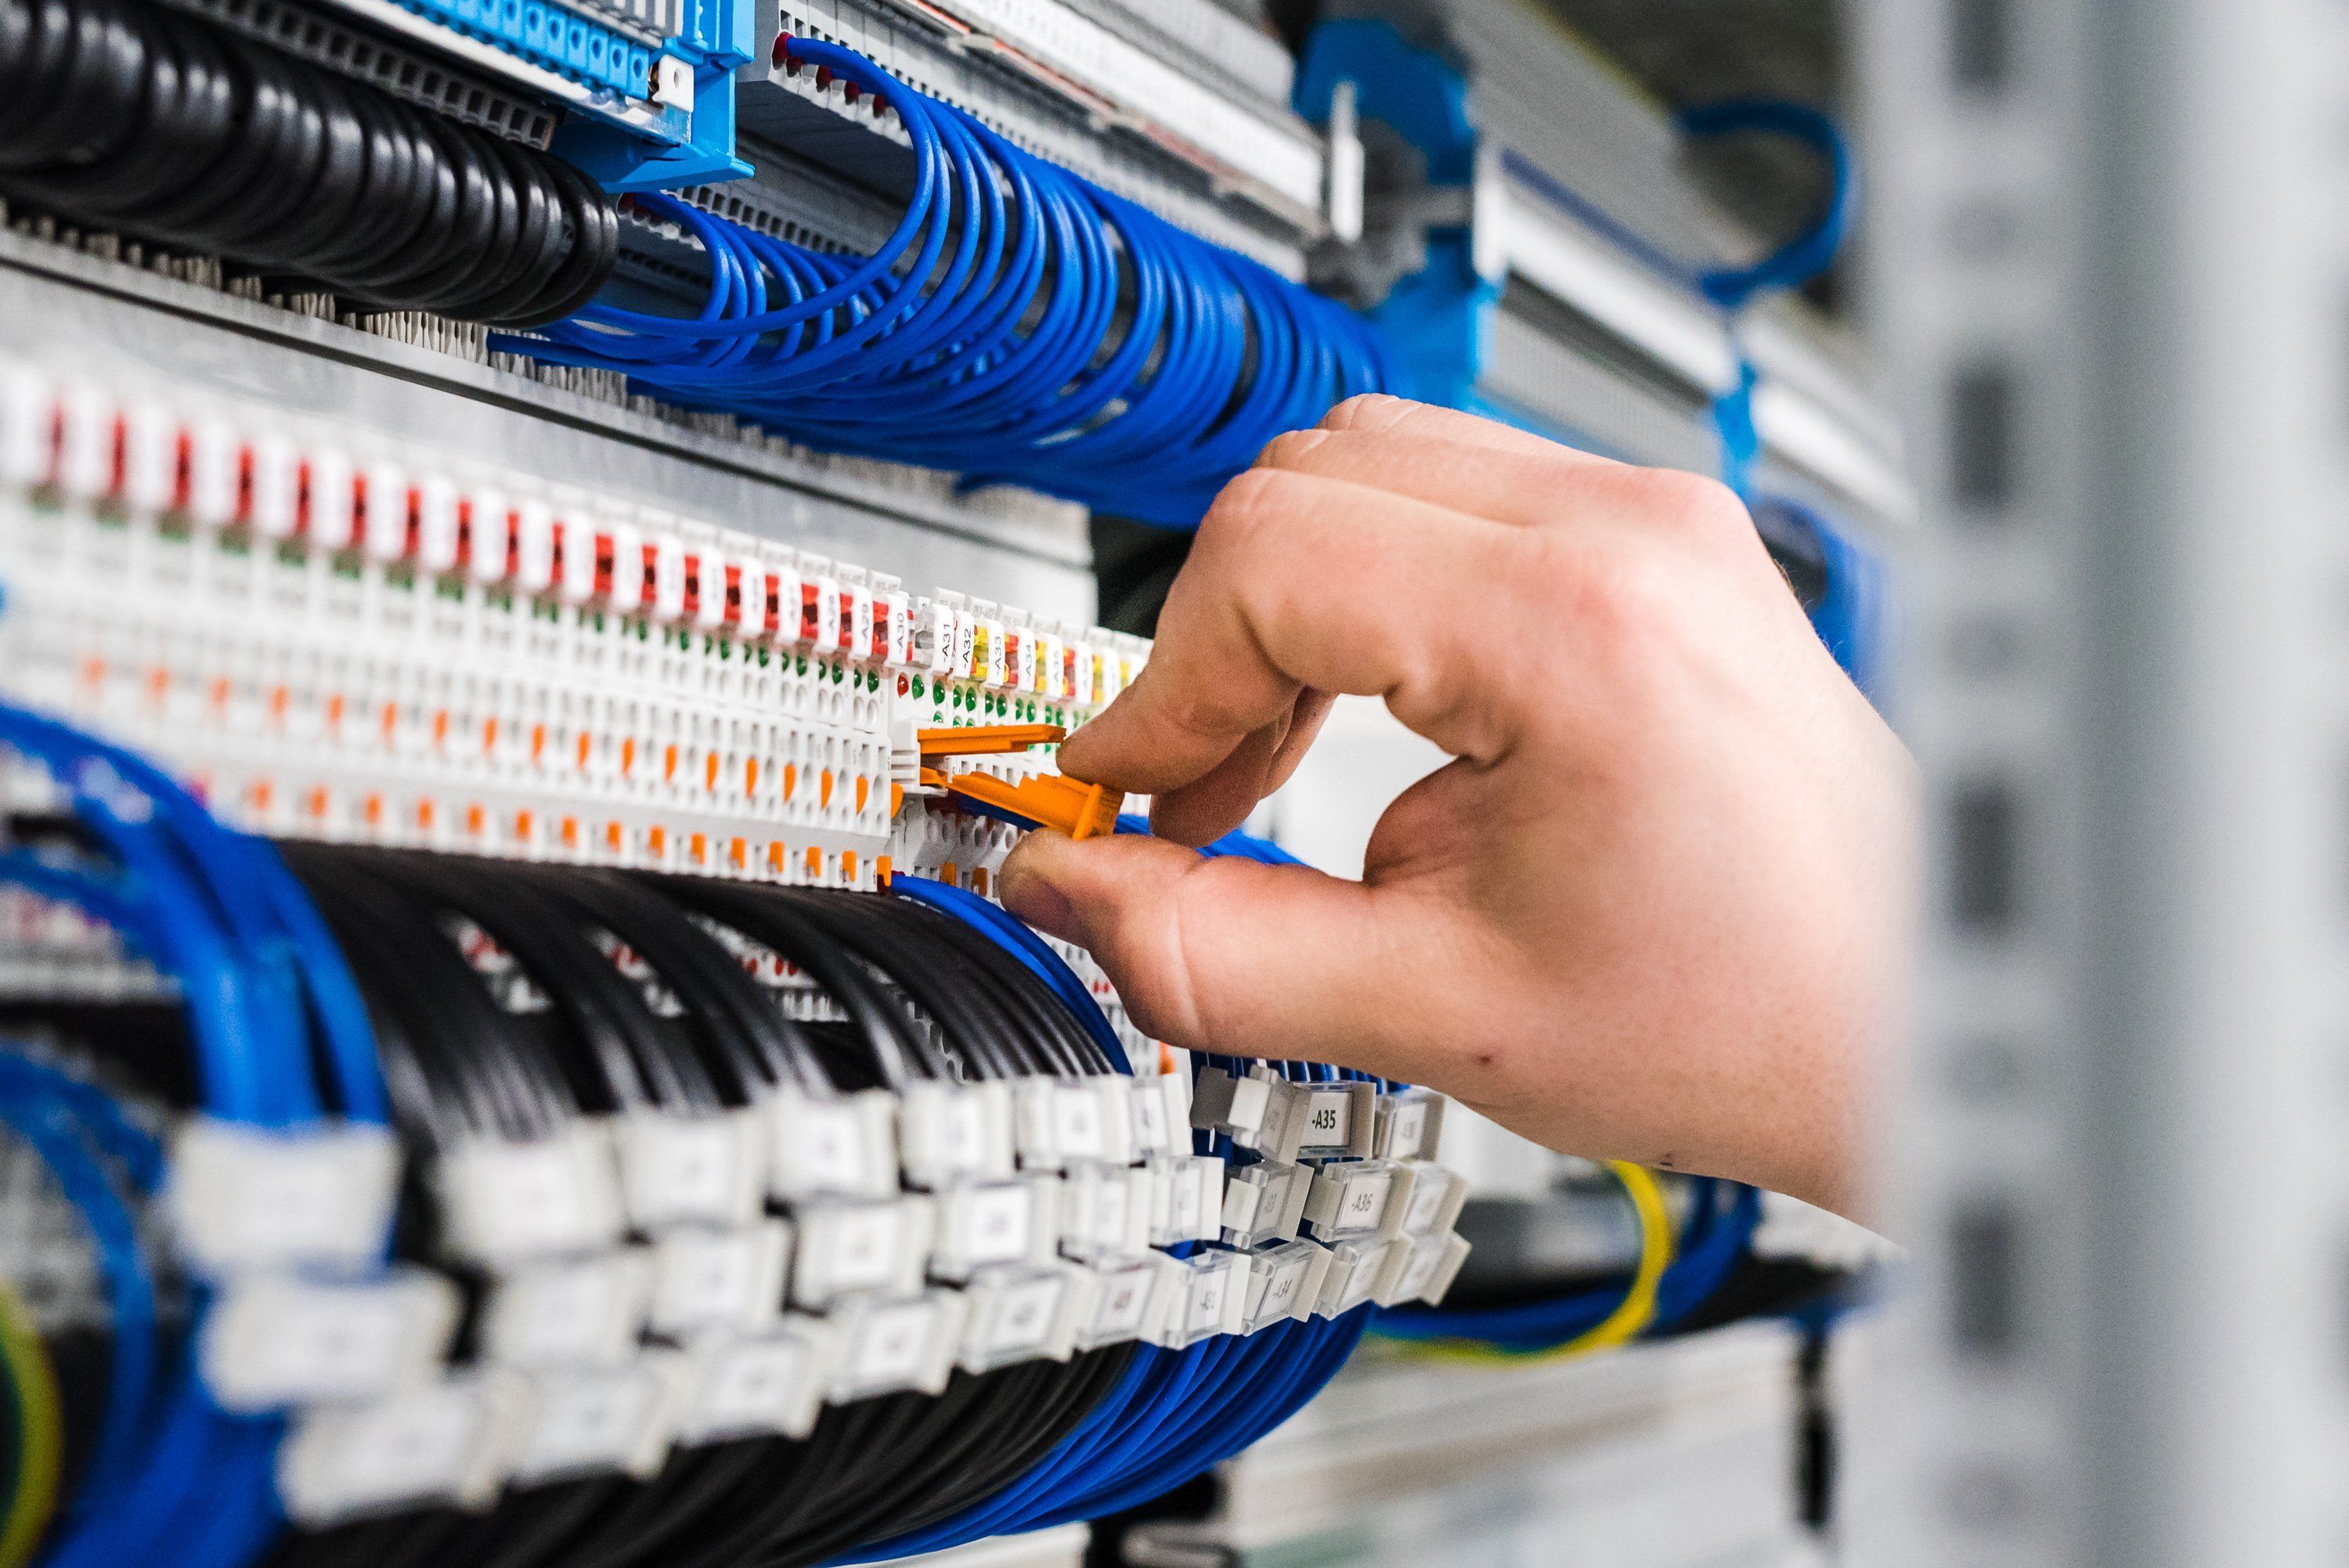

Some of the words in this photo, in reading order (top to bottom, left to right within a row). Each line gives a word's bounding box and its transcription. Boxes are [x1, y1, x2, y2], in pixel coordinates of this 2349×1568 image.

[962, 628, 971, 669] -A32
[1312, 1109, 1336, 1130] -A35
[1351, 1192, 1373, 1213] -A36
[1272, 1279, 1293, 1301] -A34
